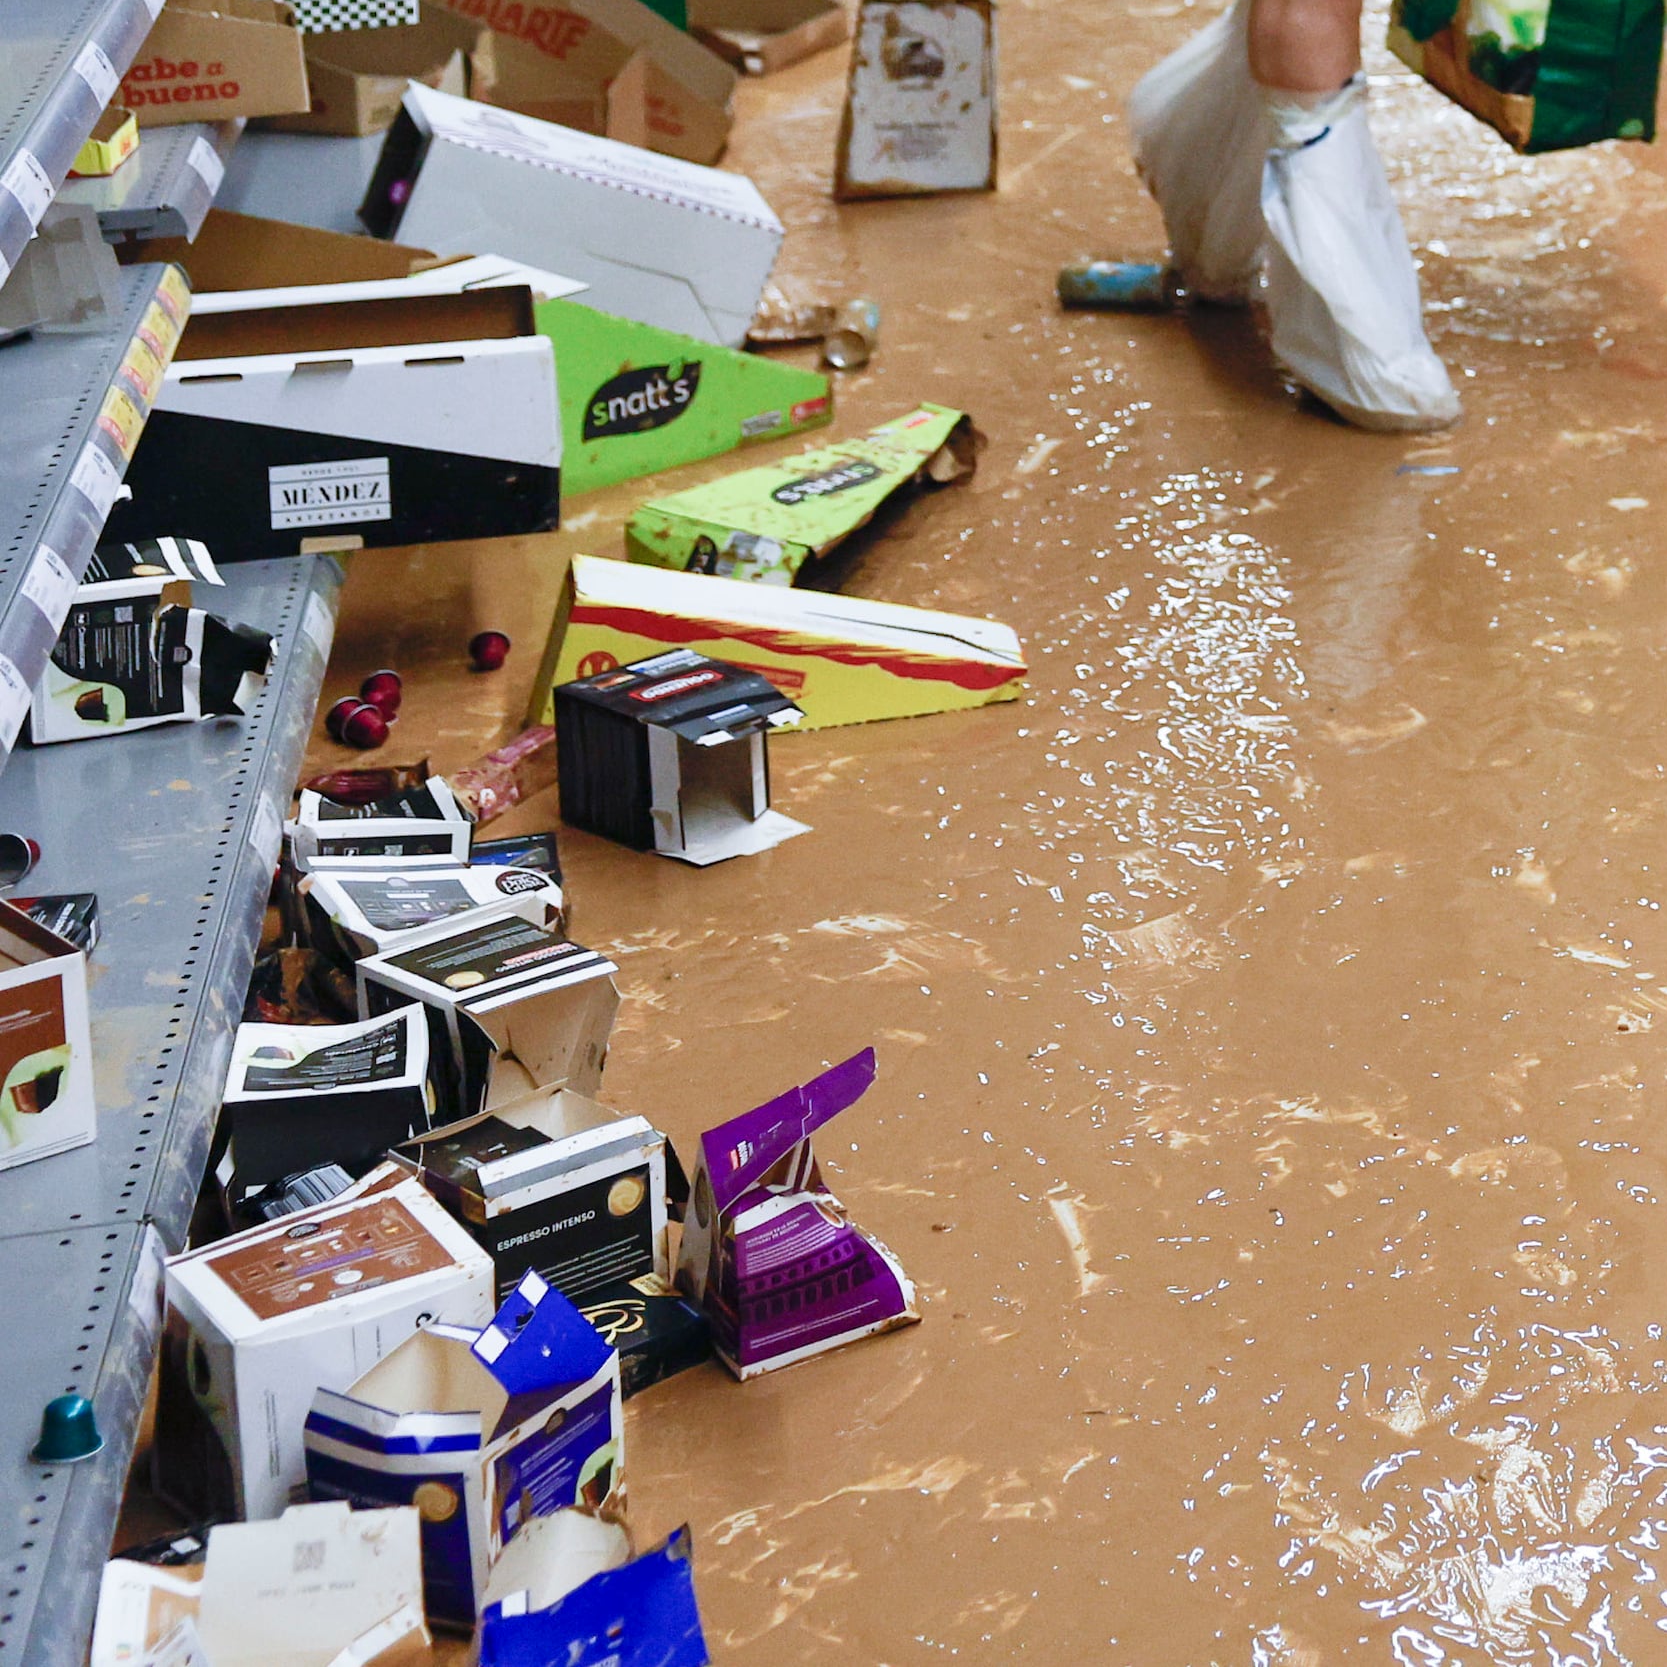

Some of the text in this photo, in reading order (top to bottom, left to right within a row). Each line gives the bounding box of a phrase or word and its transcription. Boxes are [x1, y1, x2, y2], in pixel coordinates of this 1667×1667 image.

[121, 54, 200, 83] abe
[121, 80, 241, 108] bueno
[496, 1209, 596, 1252] ESPRESSO INTENSO
